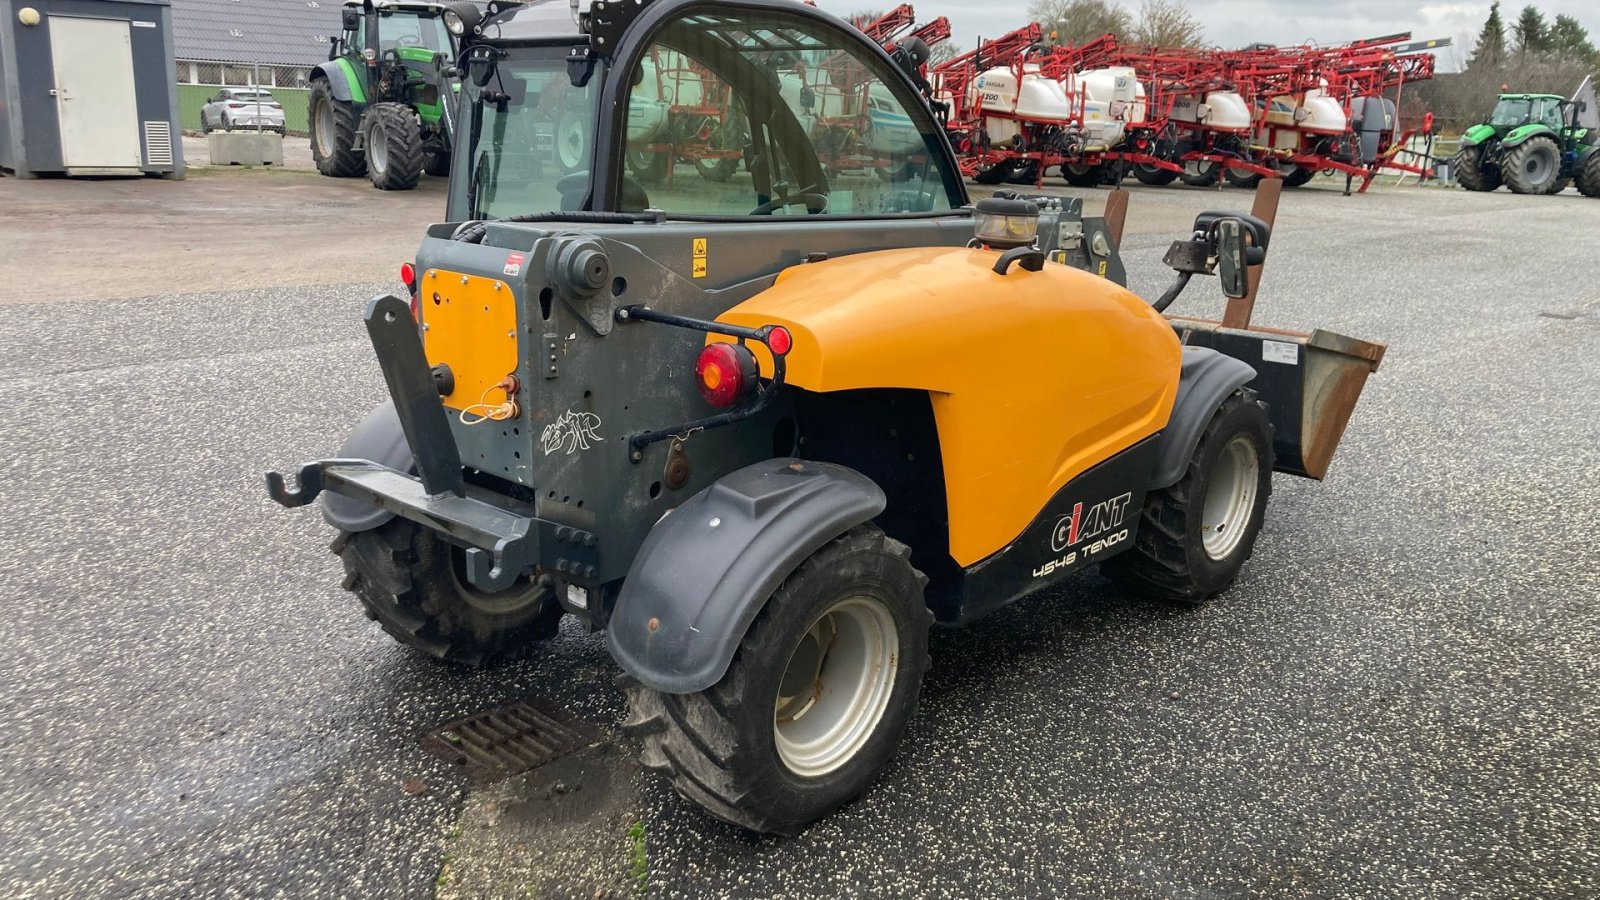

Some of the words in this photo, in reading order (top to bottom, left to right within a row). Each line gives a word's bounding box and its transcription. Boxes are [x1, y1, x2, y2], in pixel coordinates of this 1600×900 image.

[1051, 491, 1132, 552] GIANT
[1032, 551, 1077, 577] 4548
[1081, 528, 1129, 557] TENDO
